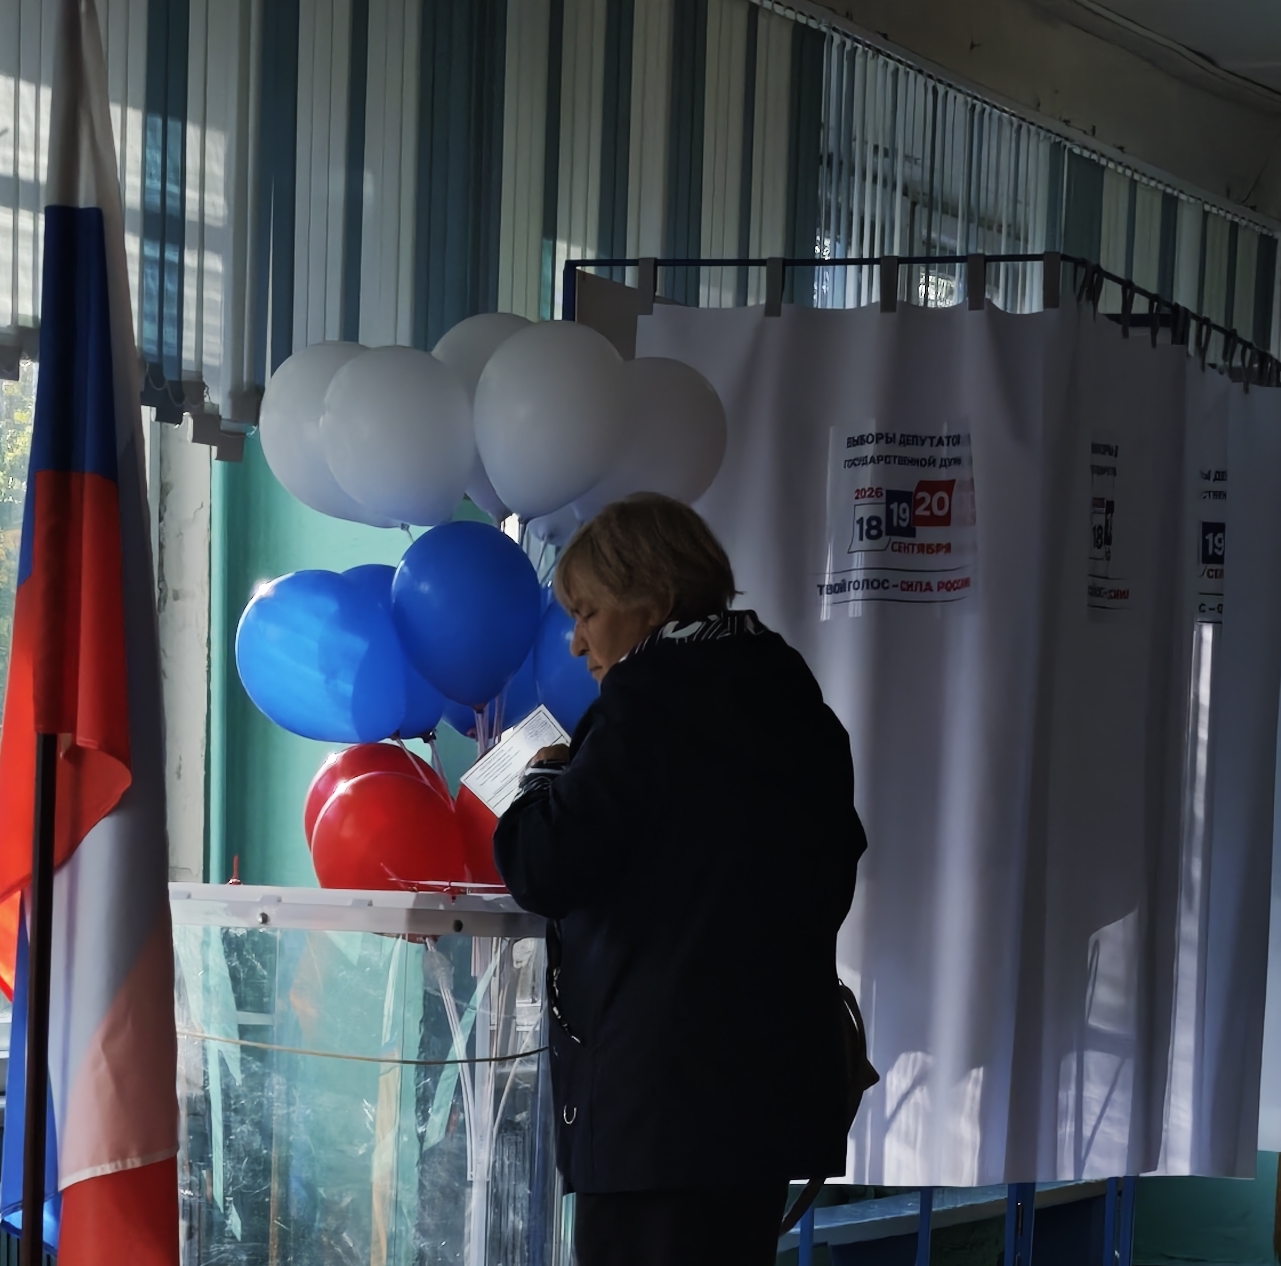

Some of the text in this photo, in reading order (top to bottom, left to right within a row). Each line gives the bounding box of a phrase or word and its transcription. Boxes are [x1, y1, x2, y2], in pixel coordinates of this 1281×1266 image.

[846, 432, 895, 448] ВЫБОРЫ
[854, 487, 884, 500] 2026
[856, 491, 950, 542] 18 19 20
[890, 541, 952, 555] СЕНТЯБРЯ
[847, 578, 890, 592] ГОЛОС
[899, 579, 934, 592] СИЛА
